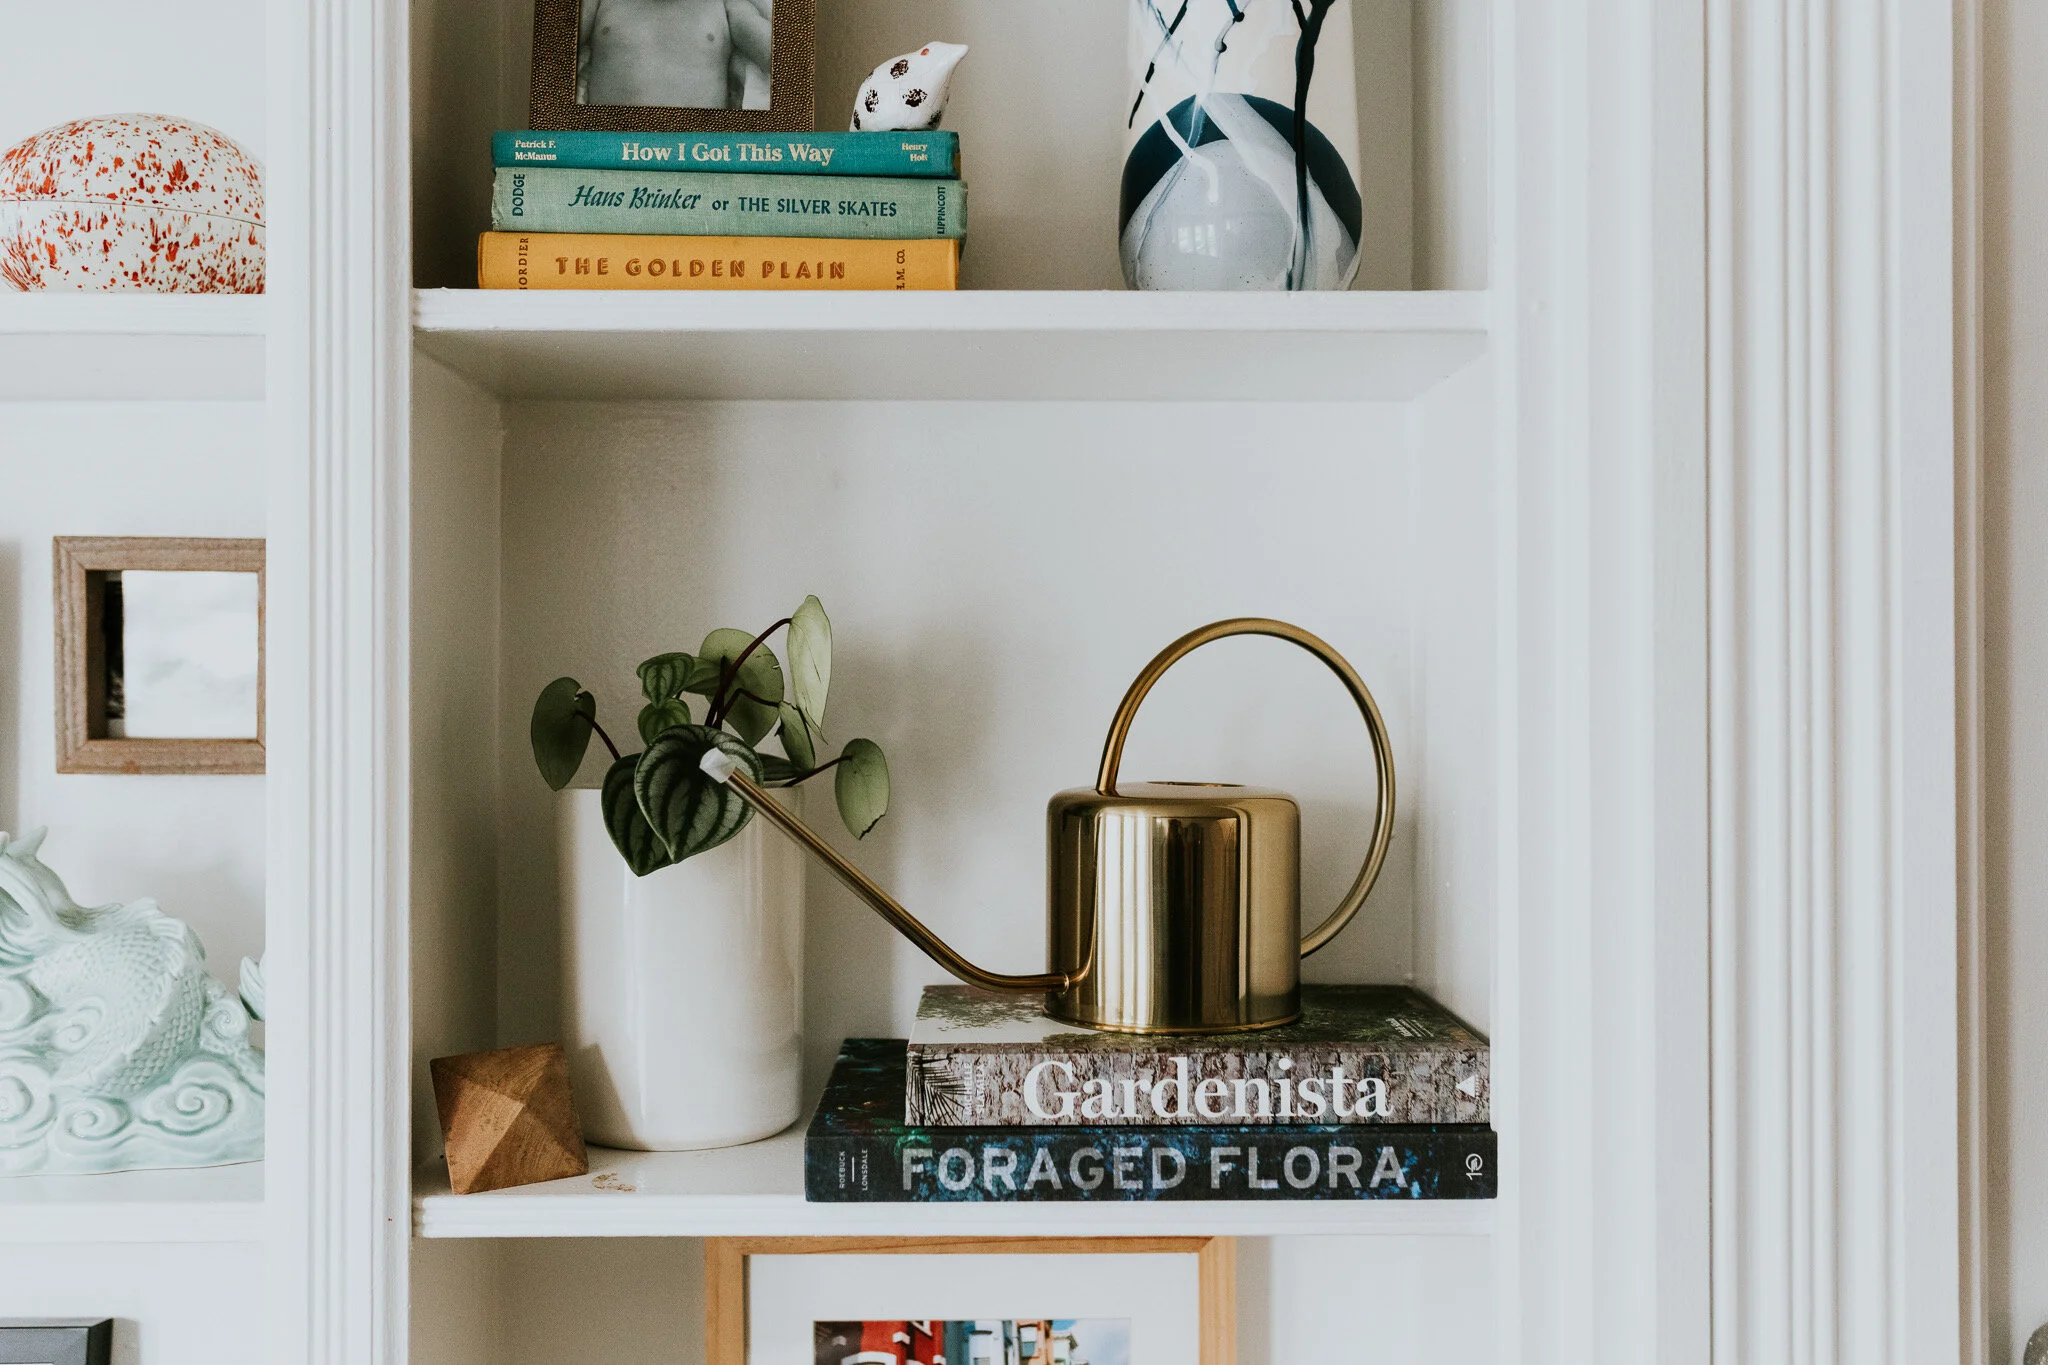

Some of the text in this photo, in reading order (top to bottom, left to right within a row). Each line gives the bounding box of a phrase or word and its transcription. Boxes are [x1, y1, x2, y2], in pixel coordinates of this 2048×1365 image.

[515, 140, 556, 148] Patrick F.
[515, 152, 557, 160] McManus
[622, 142, 834, 166] How I Got This Way
[902, 143, 927, 151] Henry
[512, 173, 525, 216] DODGE
[568, 185, 897, 217] Hans Brinker or THE SILVER SKATES
[937, 186, 946, 235] LIPPINCOTT
[555, 257, 845, 279] THE GOLDEN PLAIN
[1024, 1056, 1395, 1119] Gardenista
[902, 1146, 1409, 1191] FORAGED FLORA
